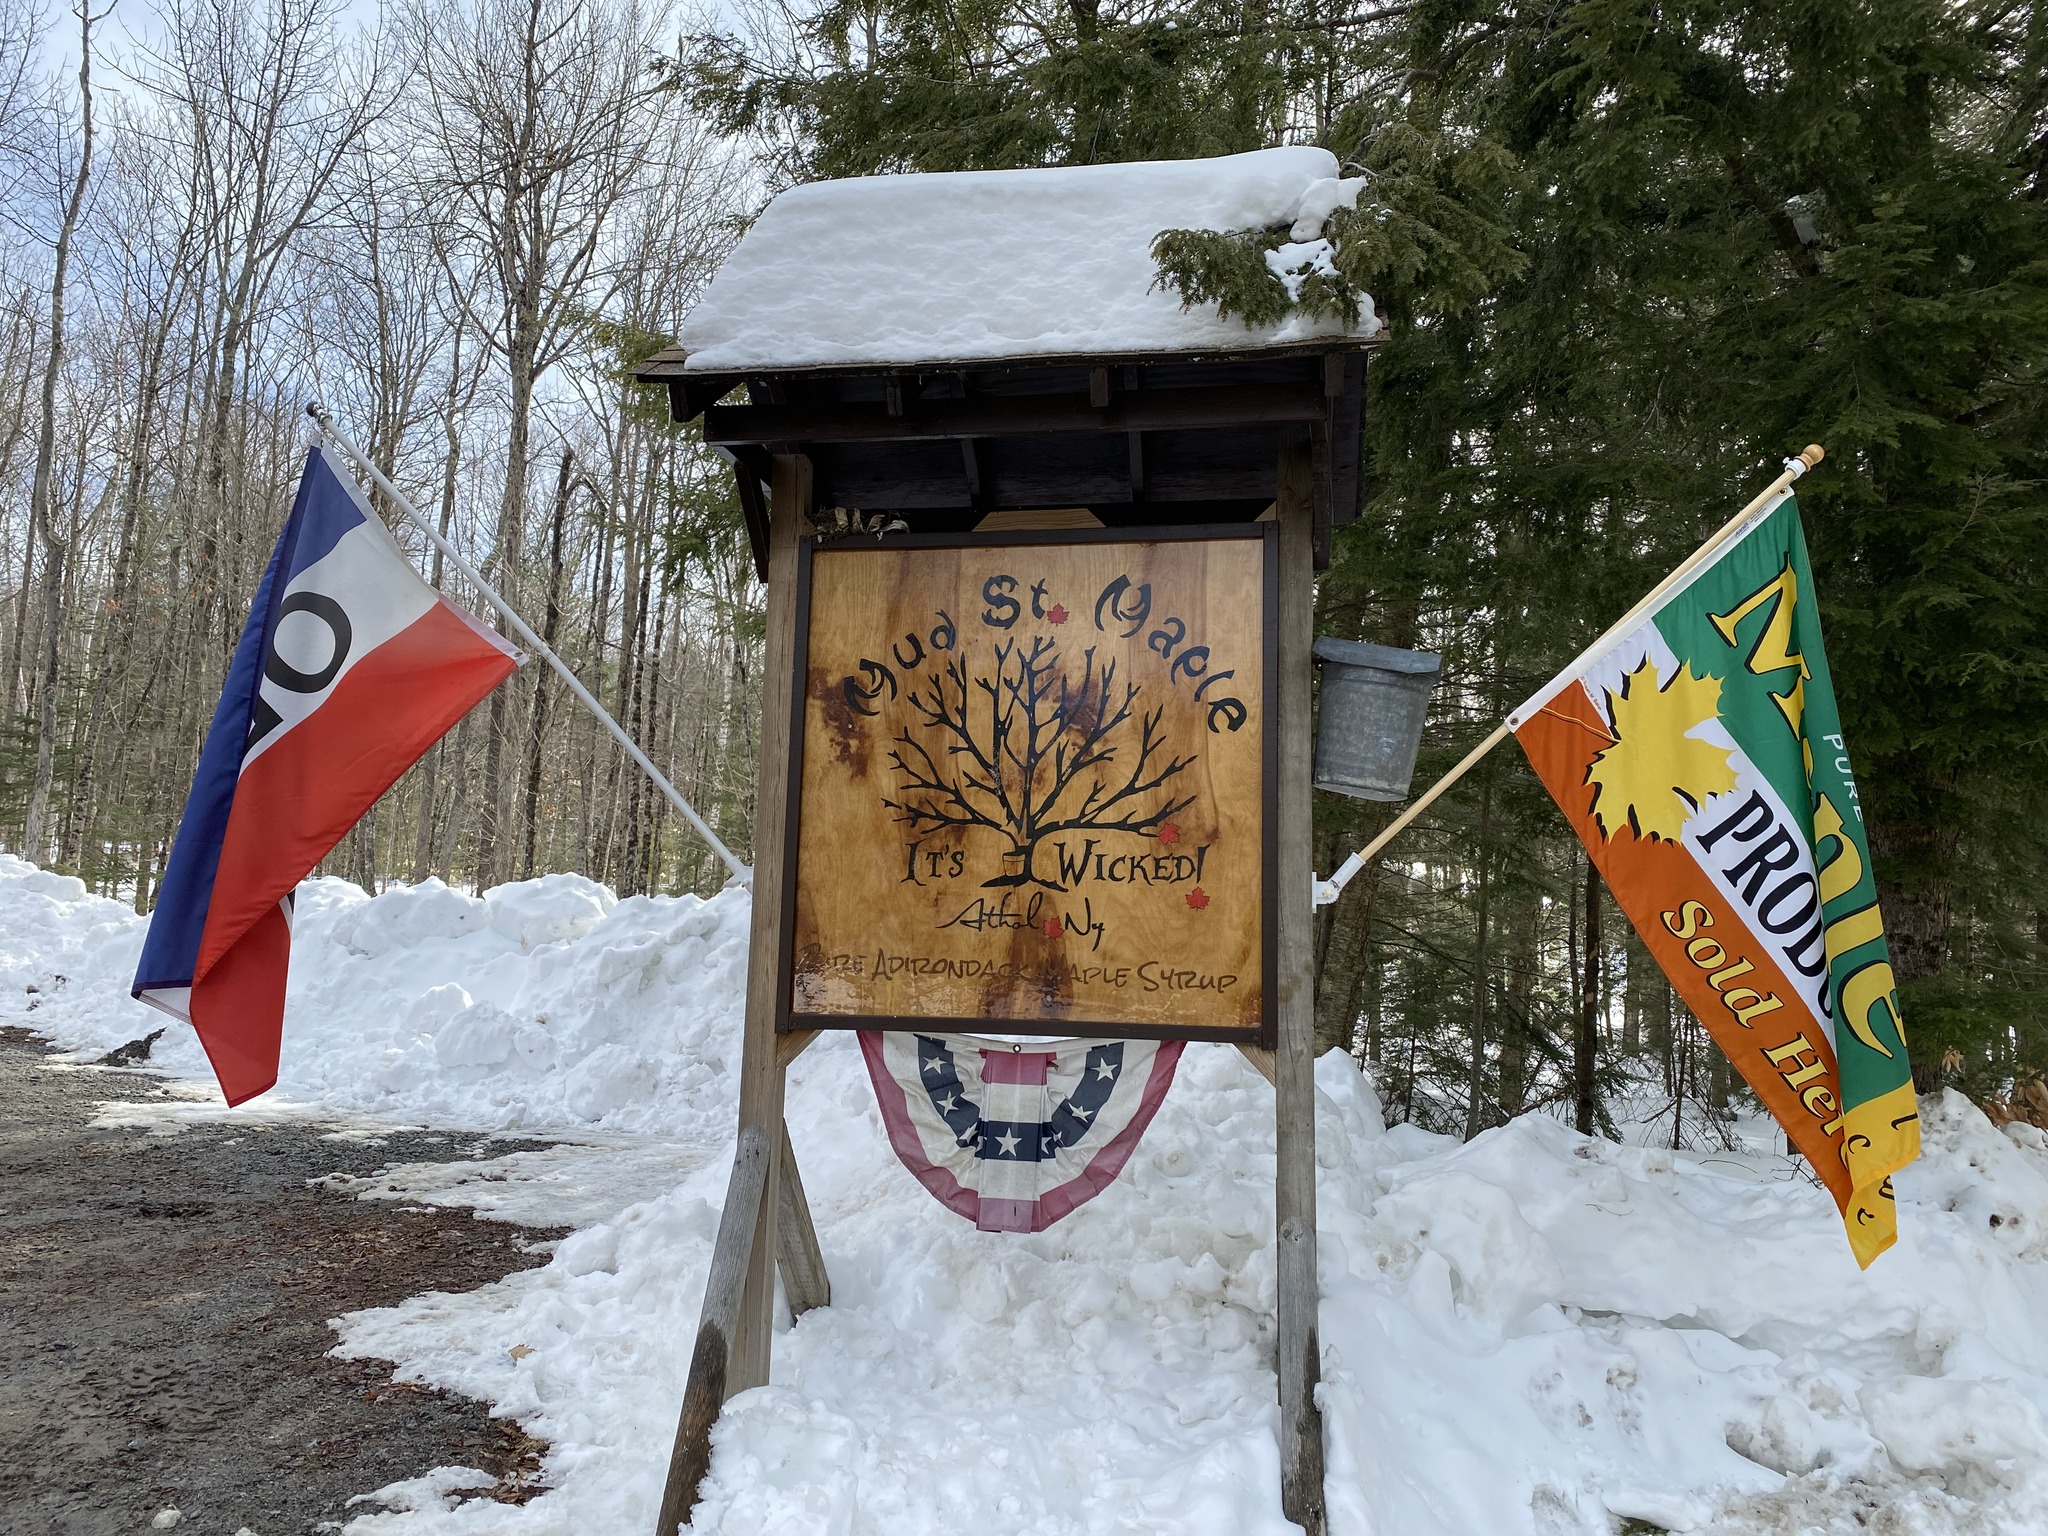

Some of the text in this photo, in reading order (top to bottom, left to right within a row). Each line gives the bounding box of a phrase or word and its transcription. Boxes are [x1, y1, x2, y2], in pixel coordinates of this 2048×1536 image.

[843, 608, 957, 717] Mud
[1094, 573, 1248, 734] Maple
[1822, 733, 1864, 823] PURE
[935, 890, 1044, 933] Athol
[871, 947, 1032, 982] ADIRONDACK
[1137, 960, 1238, 994] SYRUP
[1660, 899, 1785, 1031] Sold
